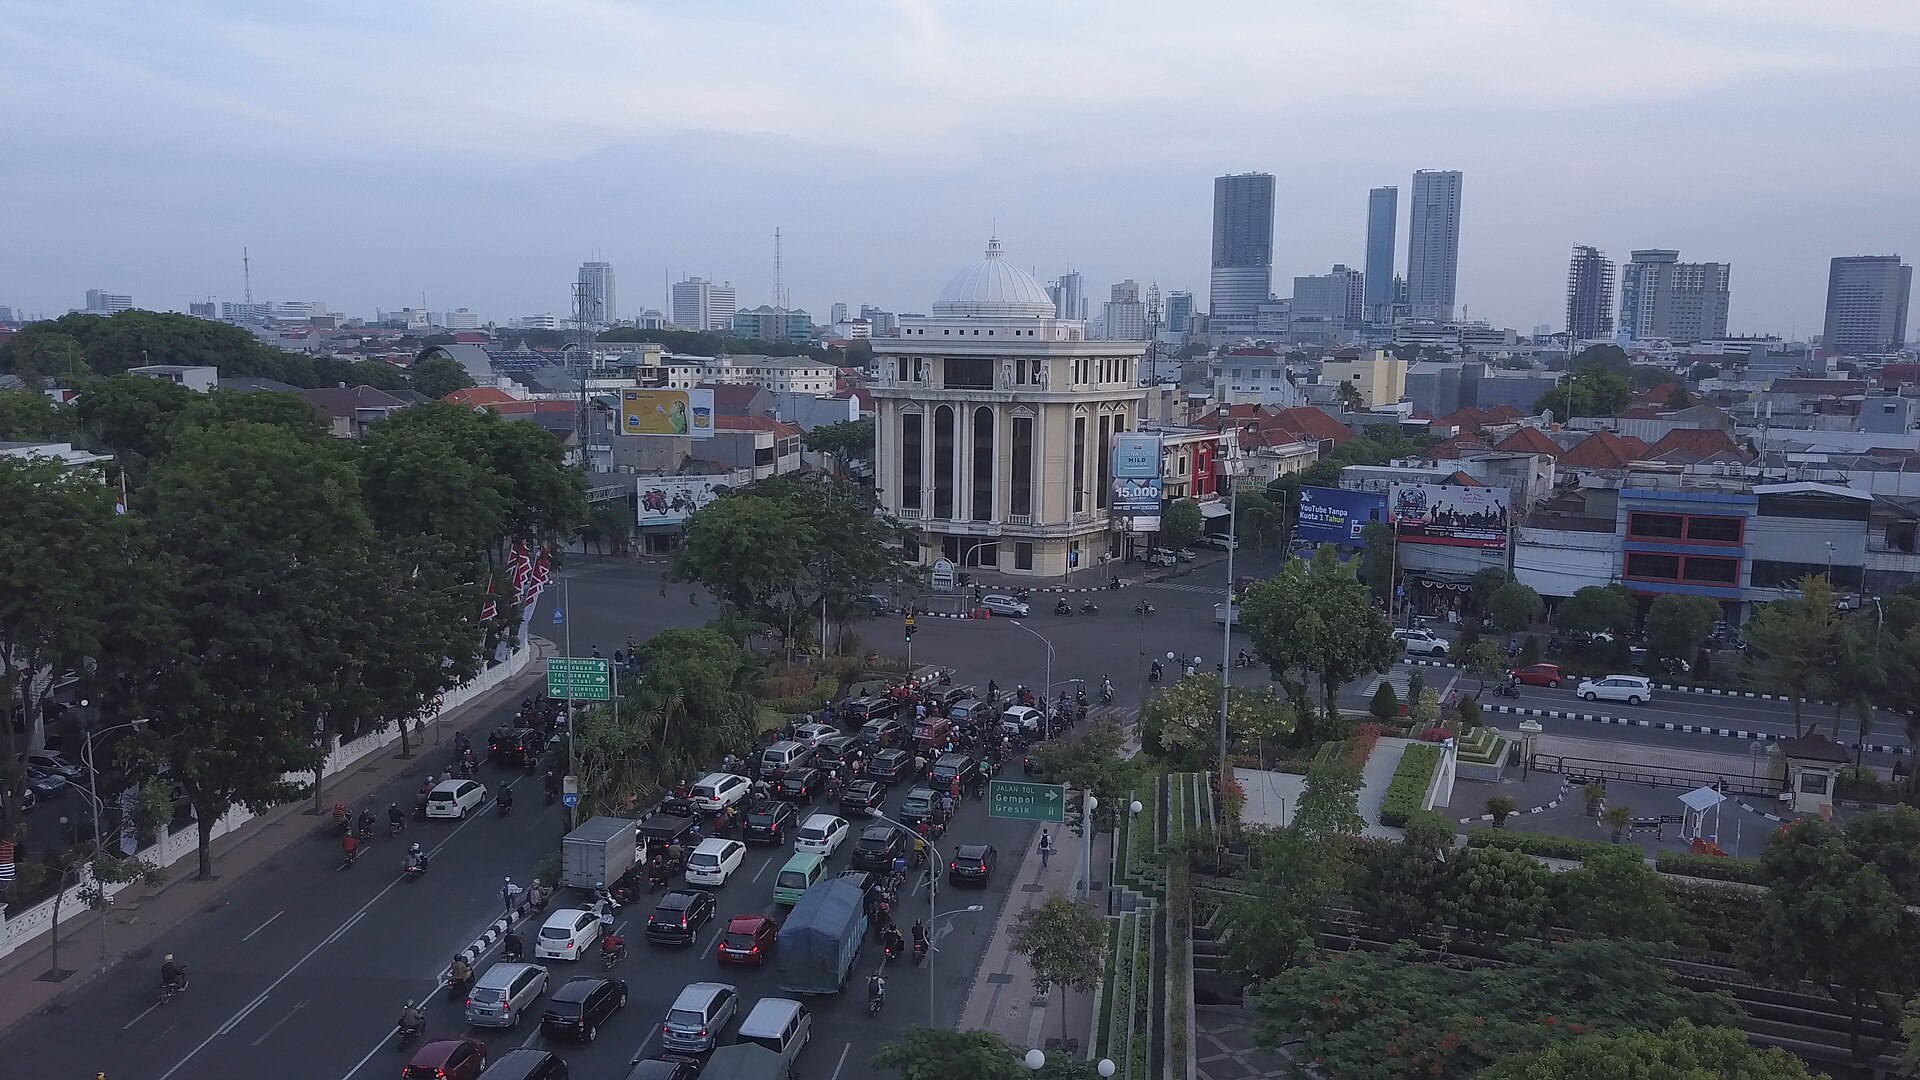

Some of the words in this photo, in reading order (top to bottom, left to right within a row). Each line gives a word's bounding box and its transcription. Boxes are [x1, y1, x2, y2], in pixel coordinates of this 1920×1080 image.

[1115, 487, 1158, 498] 15.000
[1300, 504, 1327, 514] YouTube
[1328, 507, 1348, 517] Tanpa
[1300, 511, 1318, 520] Kuota
[1325, 515, 1345, 524] Tahun
[995, 785, 1019, 793] JALAN
[995, 794, 1034, 804] Gempol
[995, 804, 1030, 814] Gresik
